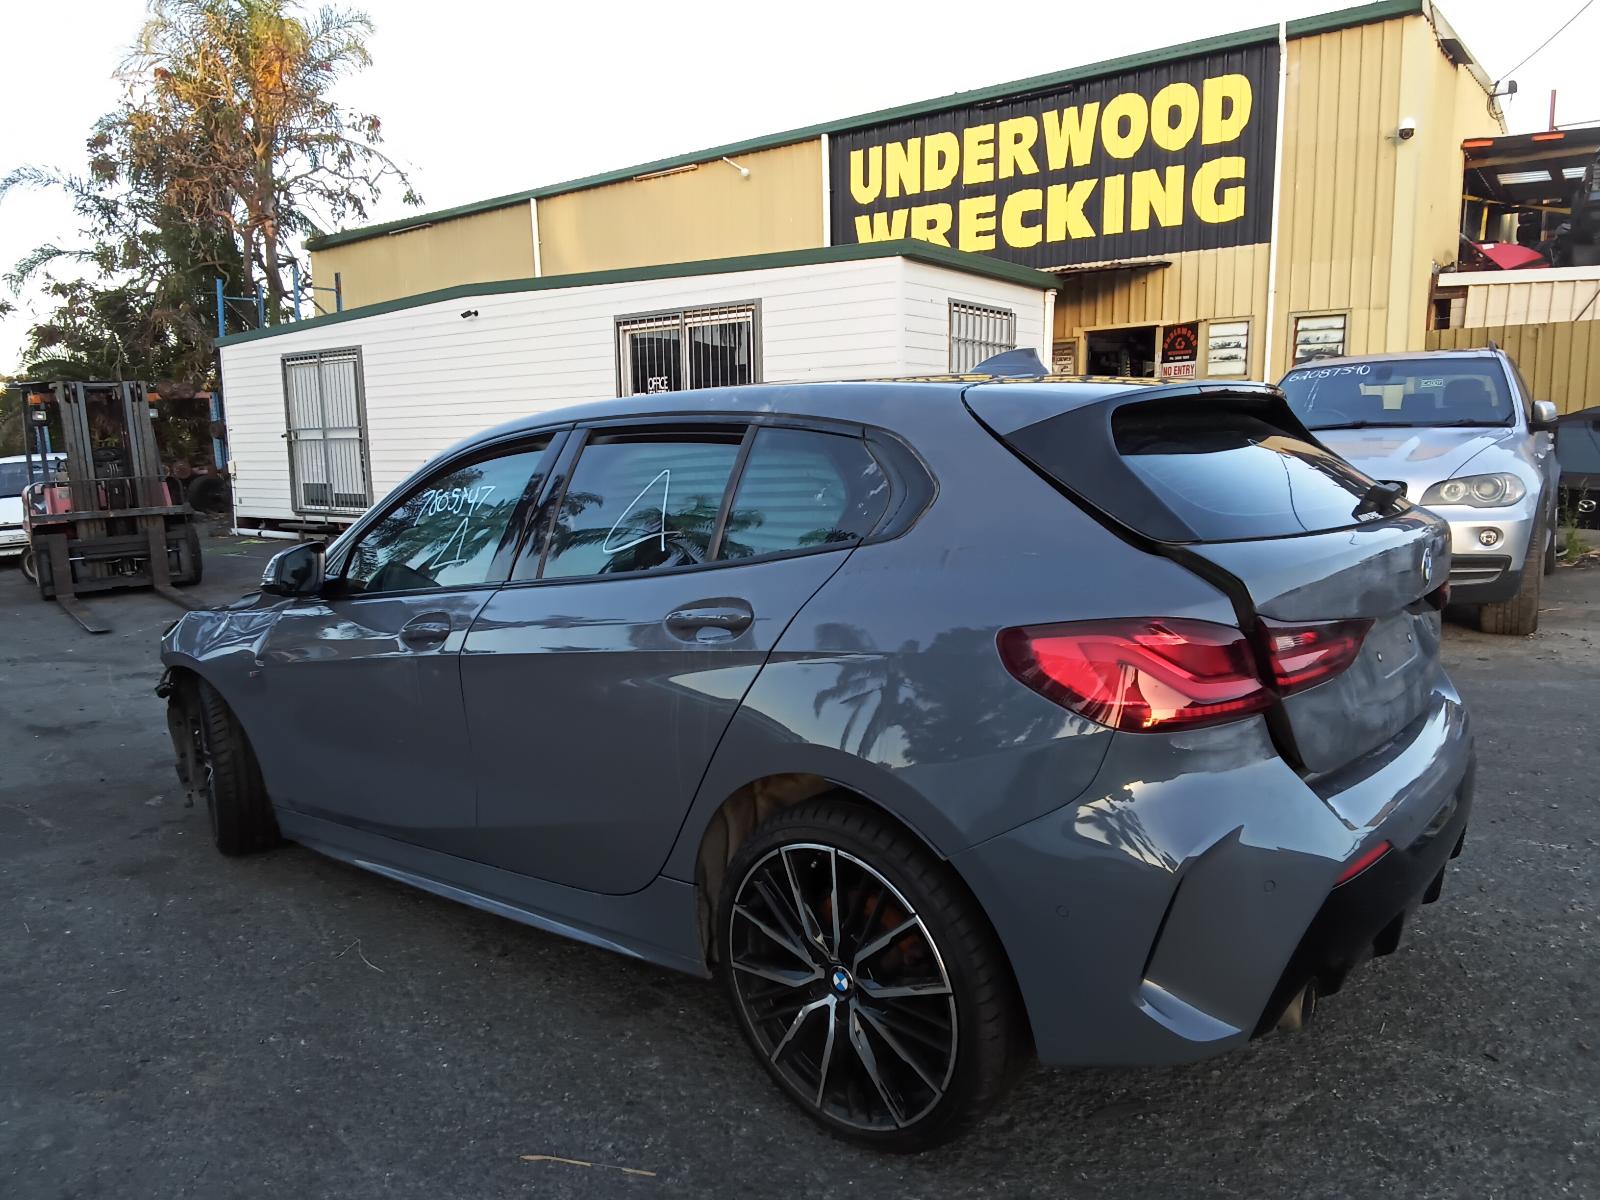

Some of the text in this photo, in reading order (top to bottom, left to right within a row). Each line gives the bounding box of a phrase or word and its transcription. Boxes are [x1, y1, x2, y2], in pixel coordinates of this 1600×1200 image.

[849, 73, 1253, 205] UNDERWOOD
[854, 156, 1247, 252] WRECKING
[1163, 364, 1195, 377] NO ENTRY
